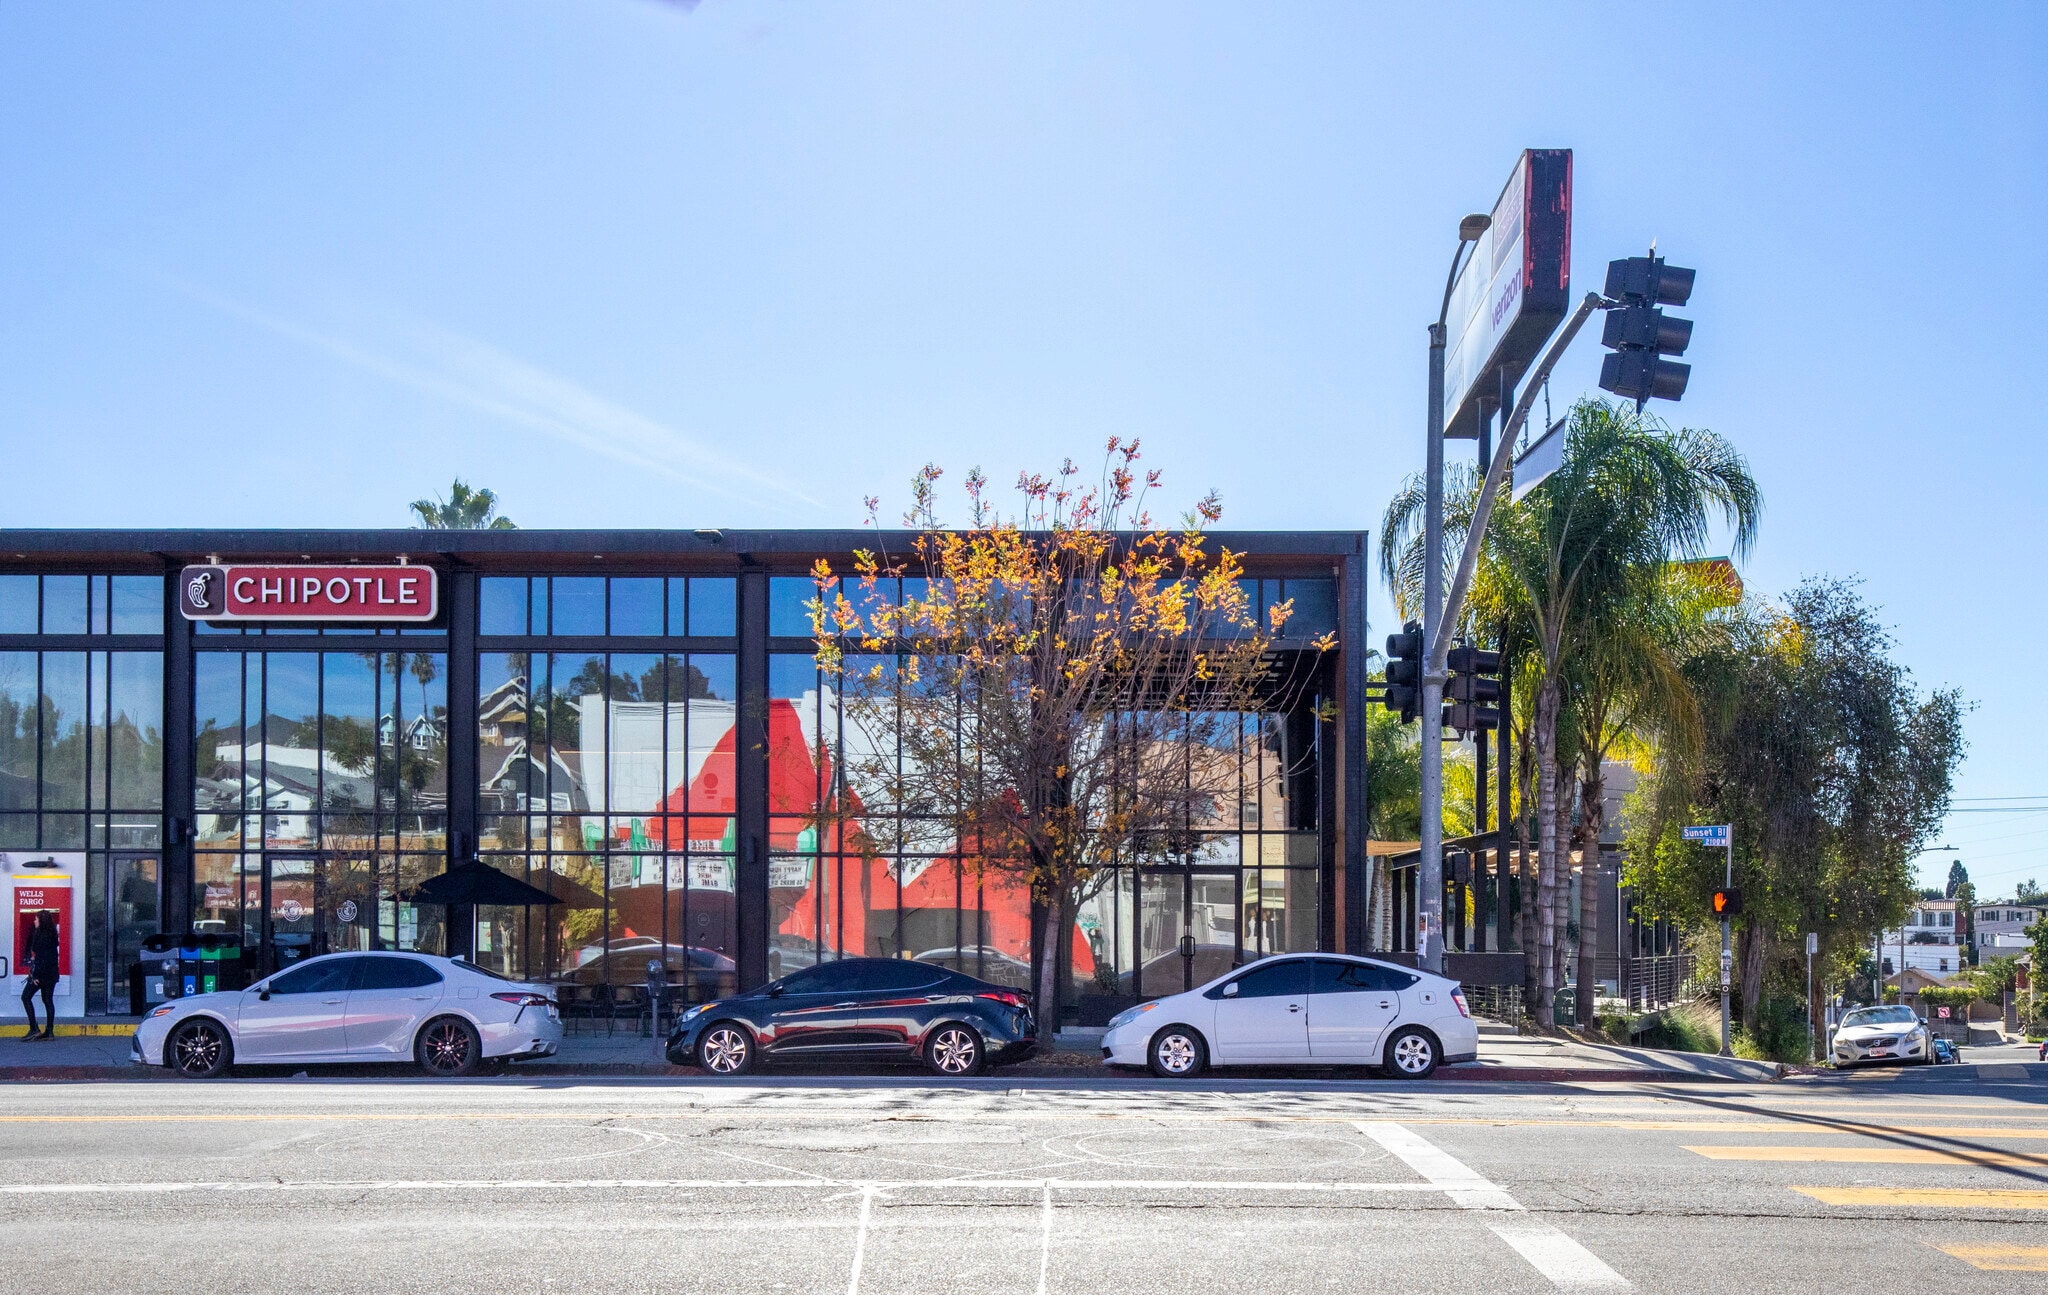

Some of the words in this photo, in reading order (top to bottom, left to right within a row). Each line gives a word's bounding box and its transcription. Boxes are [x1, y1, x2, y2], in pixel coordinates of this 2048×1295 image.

[1491, 267, 1522, 331] verizon
[233, 576, 418, 604] CHIPOTLE
[1683, 828, 1713, 837] Sunset
[1717, 827, 1726, 836] Bl
[19, 890, 44, 898] WELLS
[19, 898, 44, 906] FARGO
[401, 911, 410, 920] A
